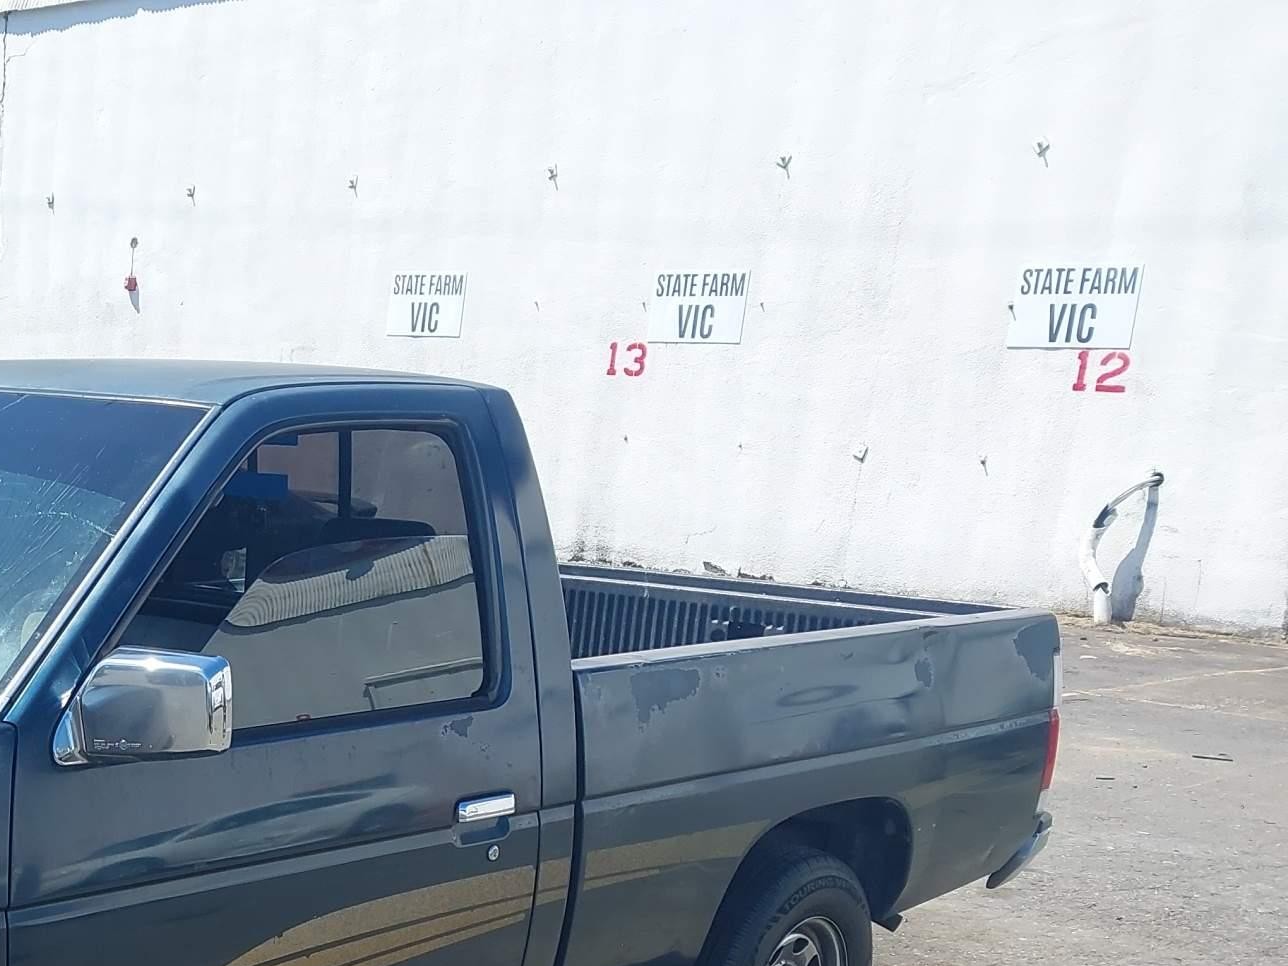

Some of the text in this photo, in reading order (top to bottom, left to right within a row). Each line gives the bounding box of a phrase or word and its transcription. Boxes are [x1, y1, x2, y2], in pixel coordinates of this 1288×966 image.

[393, 274, 464, 295] STATE FARM
[656, 273, 746, 297] STATE FARM
[1020, 267, 1139, 295] STATE FARM
[411, 302, 439, 333] VIC
[678, 304, 715, 339] VIC
[1048, 303, 1097, 343] VIC
[606, 341, 648, 377] 13
[1072, 350, 1131, 393] 12
